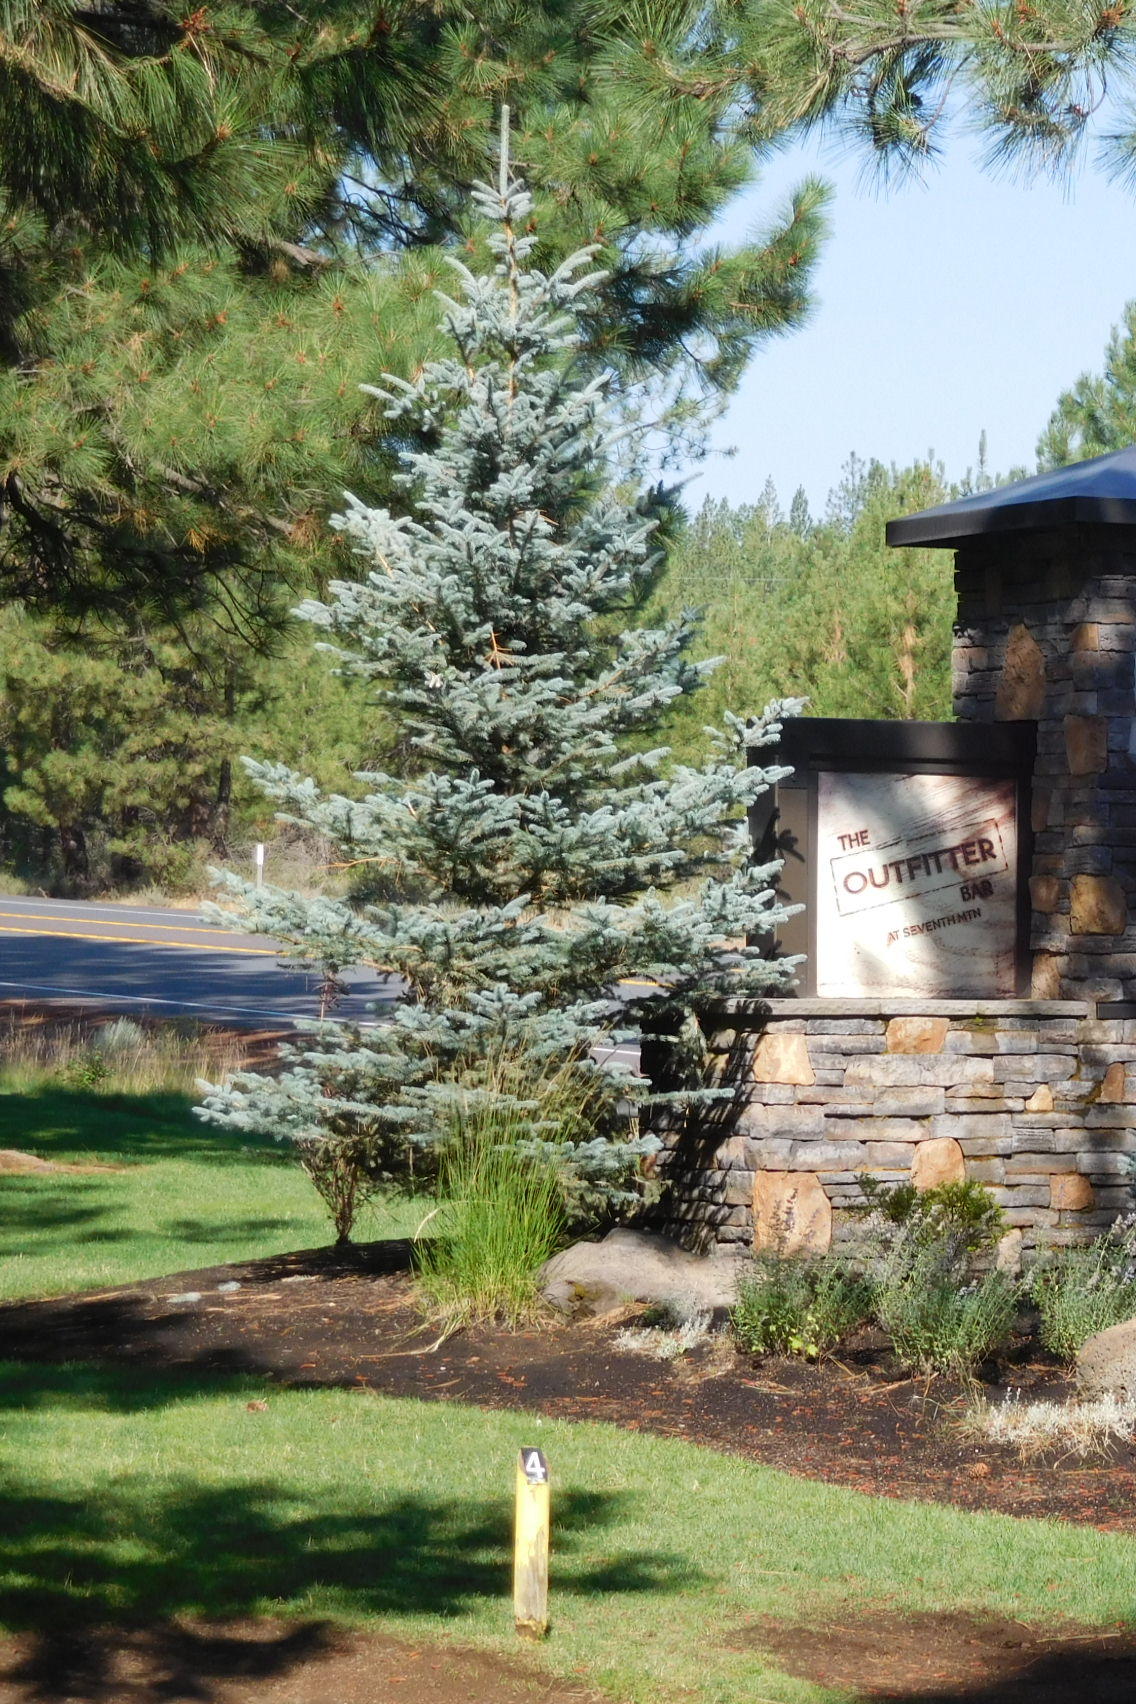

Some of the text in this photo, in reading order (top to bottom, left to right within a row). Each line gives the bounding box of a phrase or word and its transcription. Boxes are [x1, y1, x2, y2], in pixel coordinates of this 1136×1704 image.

[837, 829, 871, 851] THE
[843, 837, 997, 895] OUTFITTER
[960, 879, 994, 902] BAR
[887, 930, 899, 946] AT
[525, 1451, 546, 1479] 4
